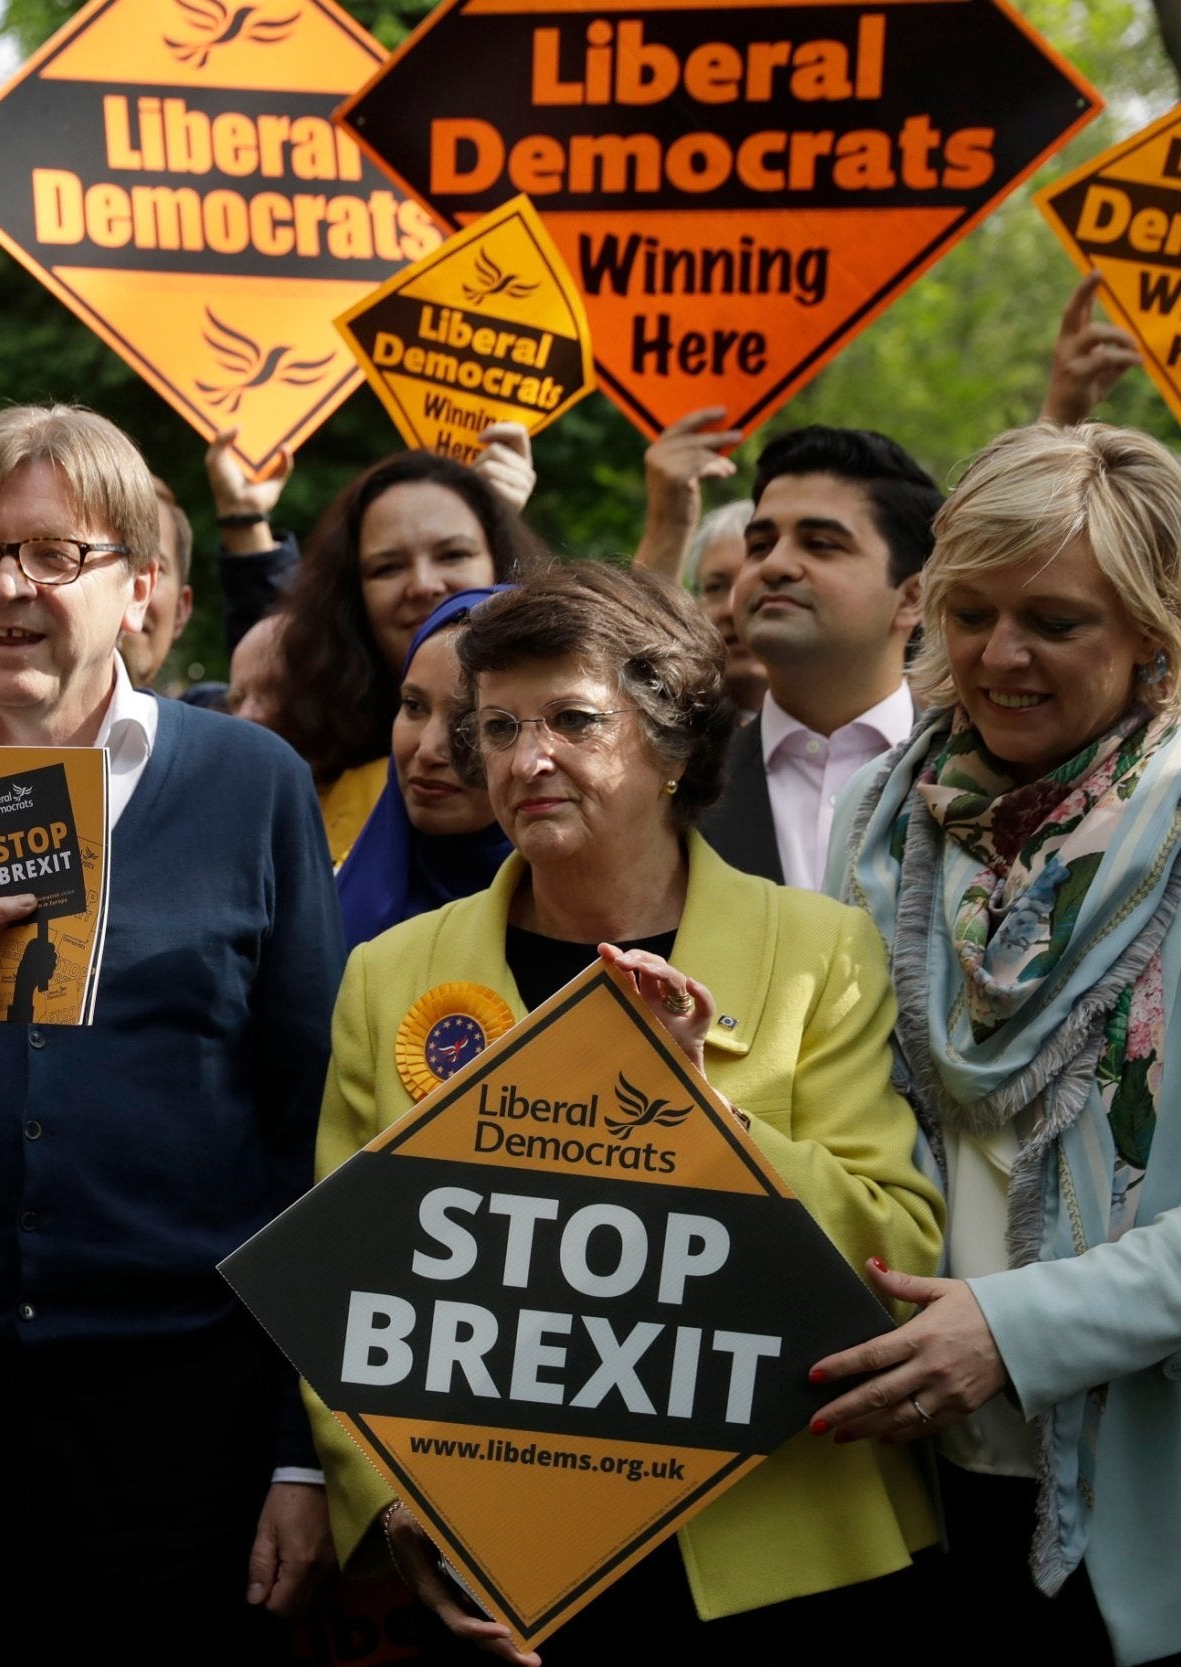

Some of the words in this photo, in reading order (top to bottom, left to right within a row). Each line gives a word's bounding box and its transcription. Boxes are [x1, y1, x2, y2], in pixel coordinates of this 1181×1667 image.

[532, 14, 886, 106] Liberal
[103, 95, 363, 181] Liberal
[430, 115, 995, 195] Democrats
[32, 168, 443, 261] Democrats
[578, 232, 831, 306] Winning
[373, 332, 564, 410] Democrats
[419, 305, 554, 369] Liberal
[631, 313, 768, 377] Here
[477, 1083, 598, 1129] Liberal
[474, 1121, 676, 1174] Democrats
[411, 1186, 731, 1305] STOP
[339, 1290, 783, 1425] BREXIT
[409, 1434, 685, 1481] www.libdems.org.uk
